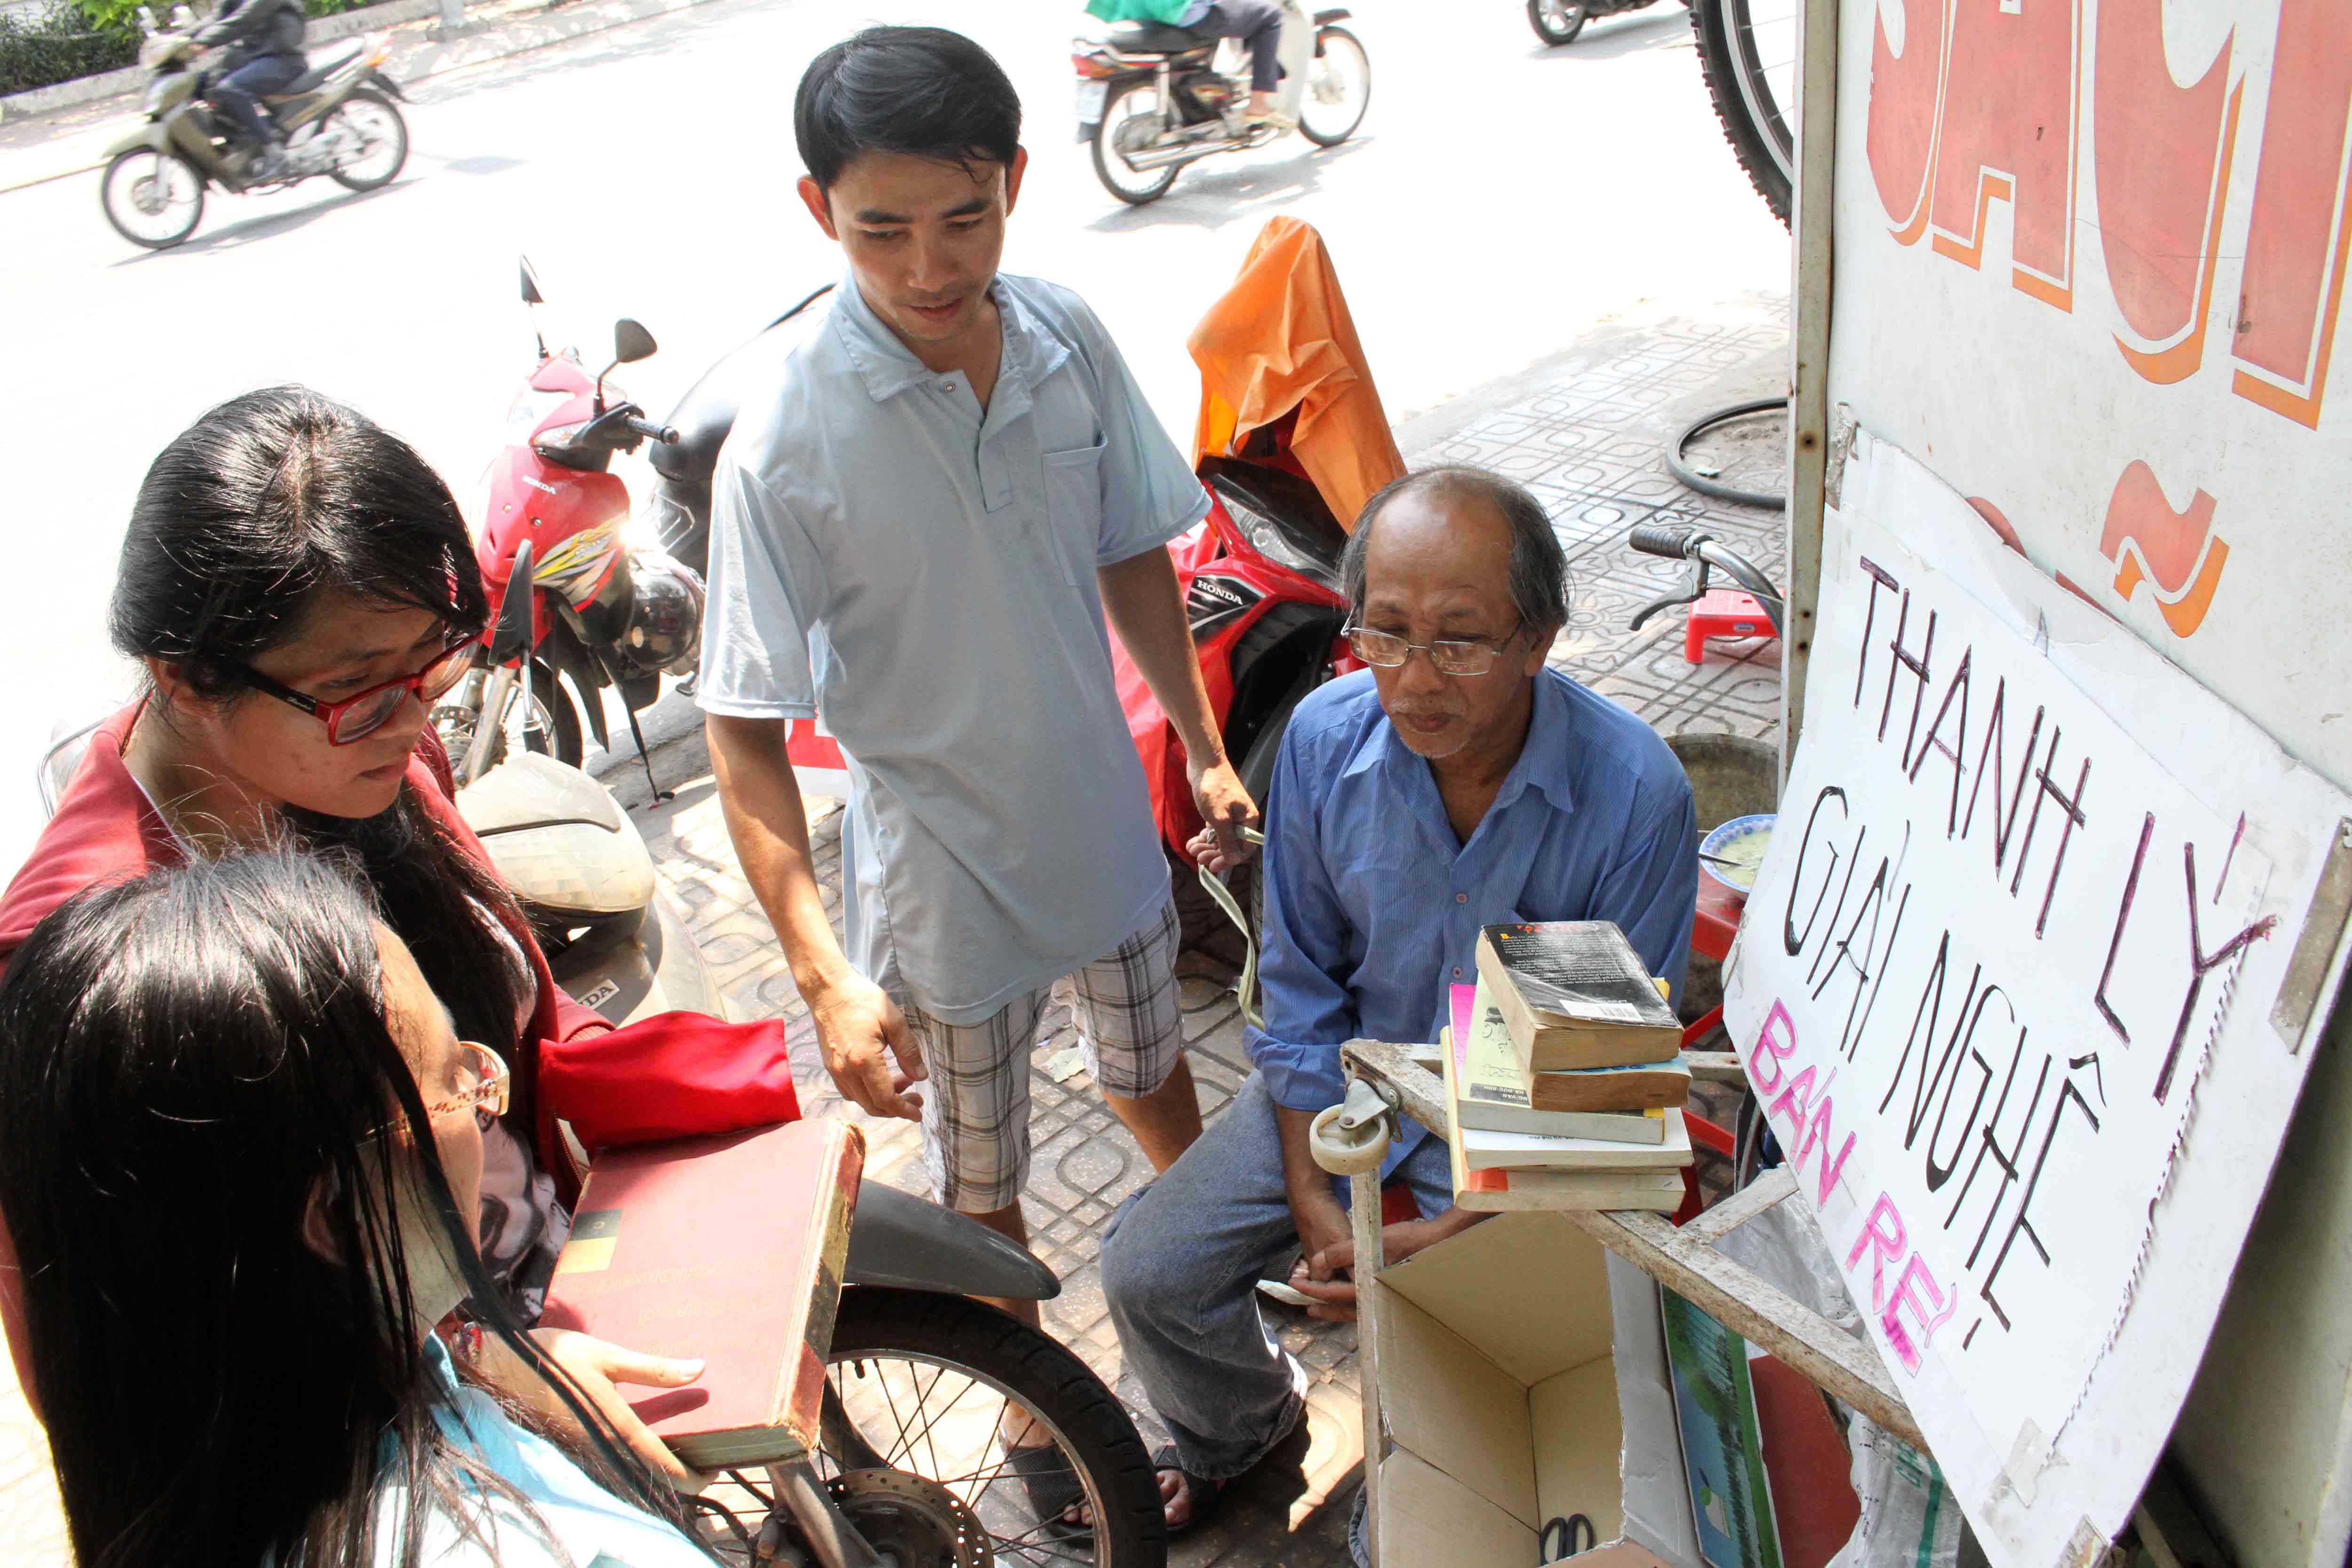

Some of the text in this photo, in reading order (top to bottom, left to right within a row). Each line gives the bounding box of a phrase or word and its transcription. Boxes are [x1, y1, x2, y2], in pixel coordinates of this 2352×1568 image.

[1197, 579, 1243, 605] HONDA
[1854, 555, 2276, 1107] THANH LÝ
[1749, 998, 1856, 1212] BÁN
